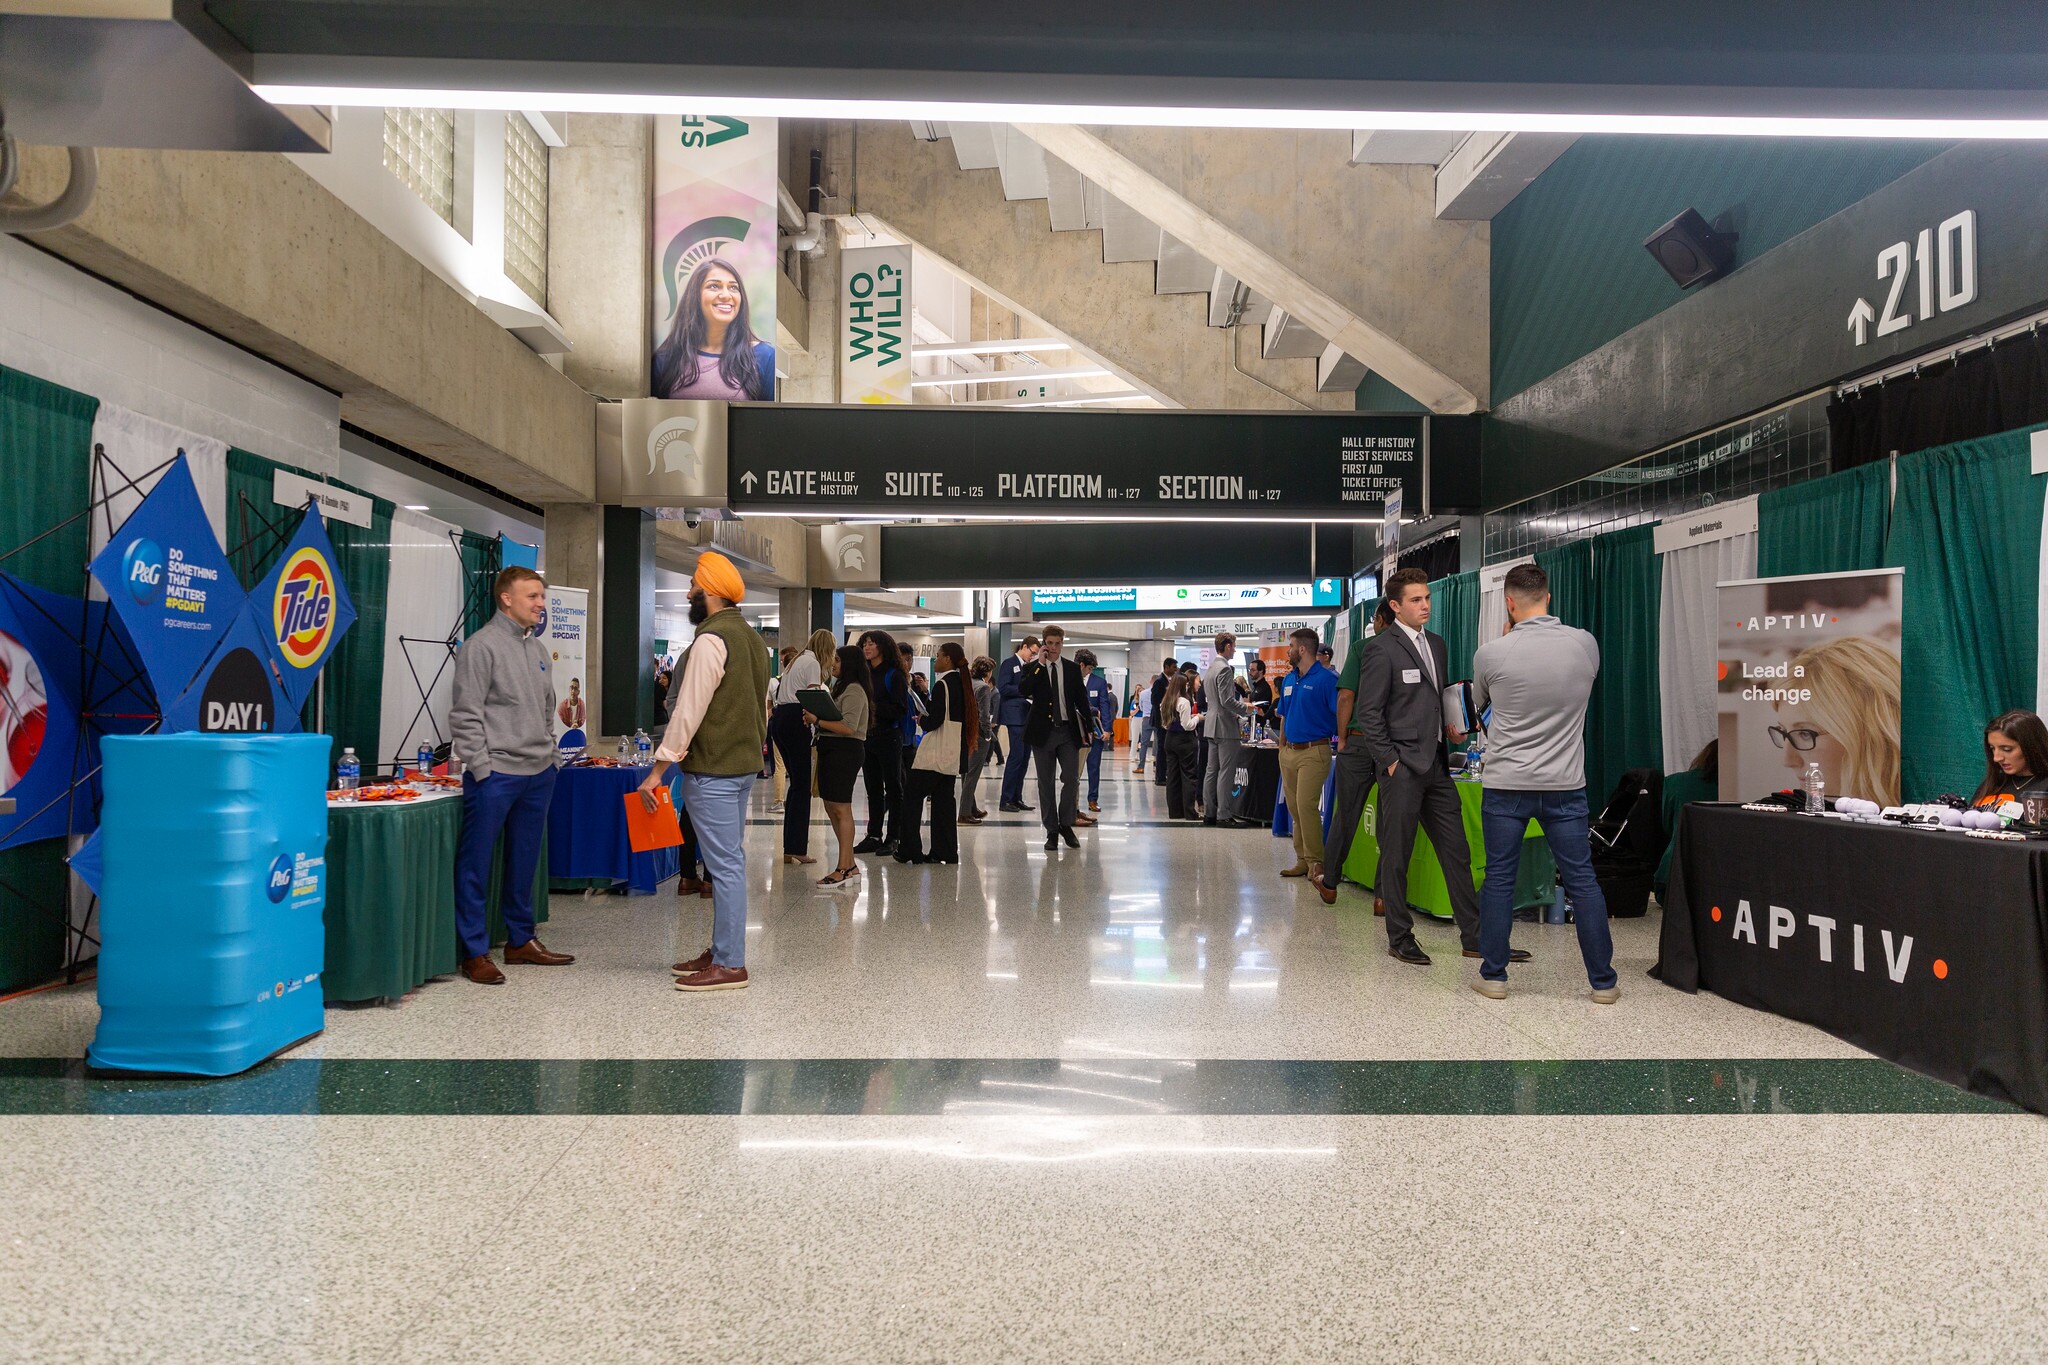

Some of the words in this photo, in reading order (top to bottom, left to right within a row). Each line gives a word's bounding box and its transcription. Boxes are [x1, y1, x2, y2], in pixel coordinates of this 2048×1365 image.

[1877, 209, 1978, 337] 210
[849, 272, 874, 362] WHO
[877, 263, 902, 367] WILL?
[1342, 437, 1363, 447] HALL
[1365, 437, 1376, 448] OF
[1378, 438, 1415, 448] HISTORY
[1342, 451, 1370, 461] GUEST
[1371, 451, 1413, 461] SERVICES
[820, 471, 842, 482] HALL
[844, 471, 855, 482] OF
[1342, 464, 1367, 474] FIRST
[1368, 464, 1383, 474] AID
[767, 470, 817, 495] GATE
[885, 472, 943, 496] SUITE
[948, 486, 960, 497] 110
[969, 486, 983, 497] 125
[998, 473, 1102, 498] PLATFORM
[1107, 489, 1118, 498] 111
[1125, 488, 1140, 499] 127
[1159, 475, 1243, 499] SECTION
[1248, 490, 1259, 499] 111
[1266, 490, 1281, 500] 127
[1342, 477, 1371, 487] TICKET
[1373, 477, 1402, 488] OFFICE
[820, 485, 859, 496] HISTORY
[1689, 524, 1702, 537] Applied
[1703, 520, 1722, 533] Materials
[169, 548, 183, 561] DO
[130, 560, 161, 585] P&G
[168, 561, 218, 580] SOMETHING
[167, 573, 191, 587] THAT
[166, 585, 206, 601] MATTERS
[1034, 595, 1056, 603] Supply
[1077, 594, 1121, 603] Management
[165, 597, 204, 613] #PGDAY1
[551, 598, 561, 606] DO
[278, 578, 331, 645] Tide
[552, 607, 586, 616] SOMETHING
[552, 615, 568, 623] THAT
[164, 618, 211, 630] pgcareers.com
[552, 623, 580, 632] MATTERS
[1198, 624, 1214, 634] GATE
[1234, 623, 1254, 633] SUITE
[1747, 613, 1827, 631] APTIV
[552, 632, 579, 640] #PGDAY1
[1742, 662, 1788, 678] Lead
[1794, 665, 1805, 678] a
[1742, 685, 1811, 705] change
[296, 852, 305, 861] DO
[270, 868, 292, 887] P&G
[1732, 899, 1914, 984] APTIV
